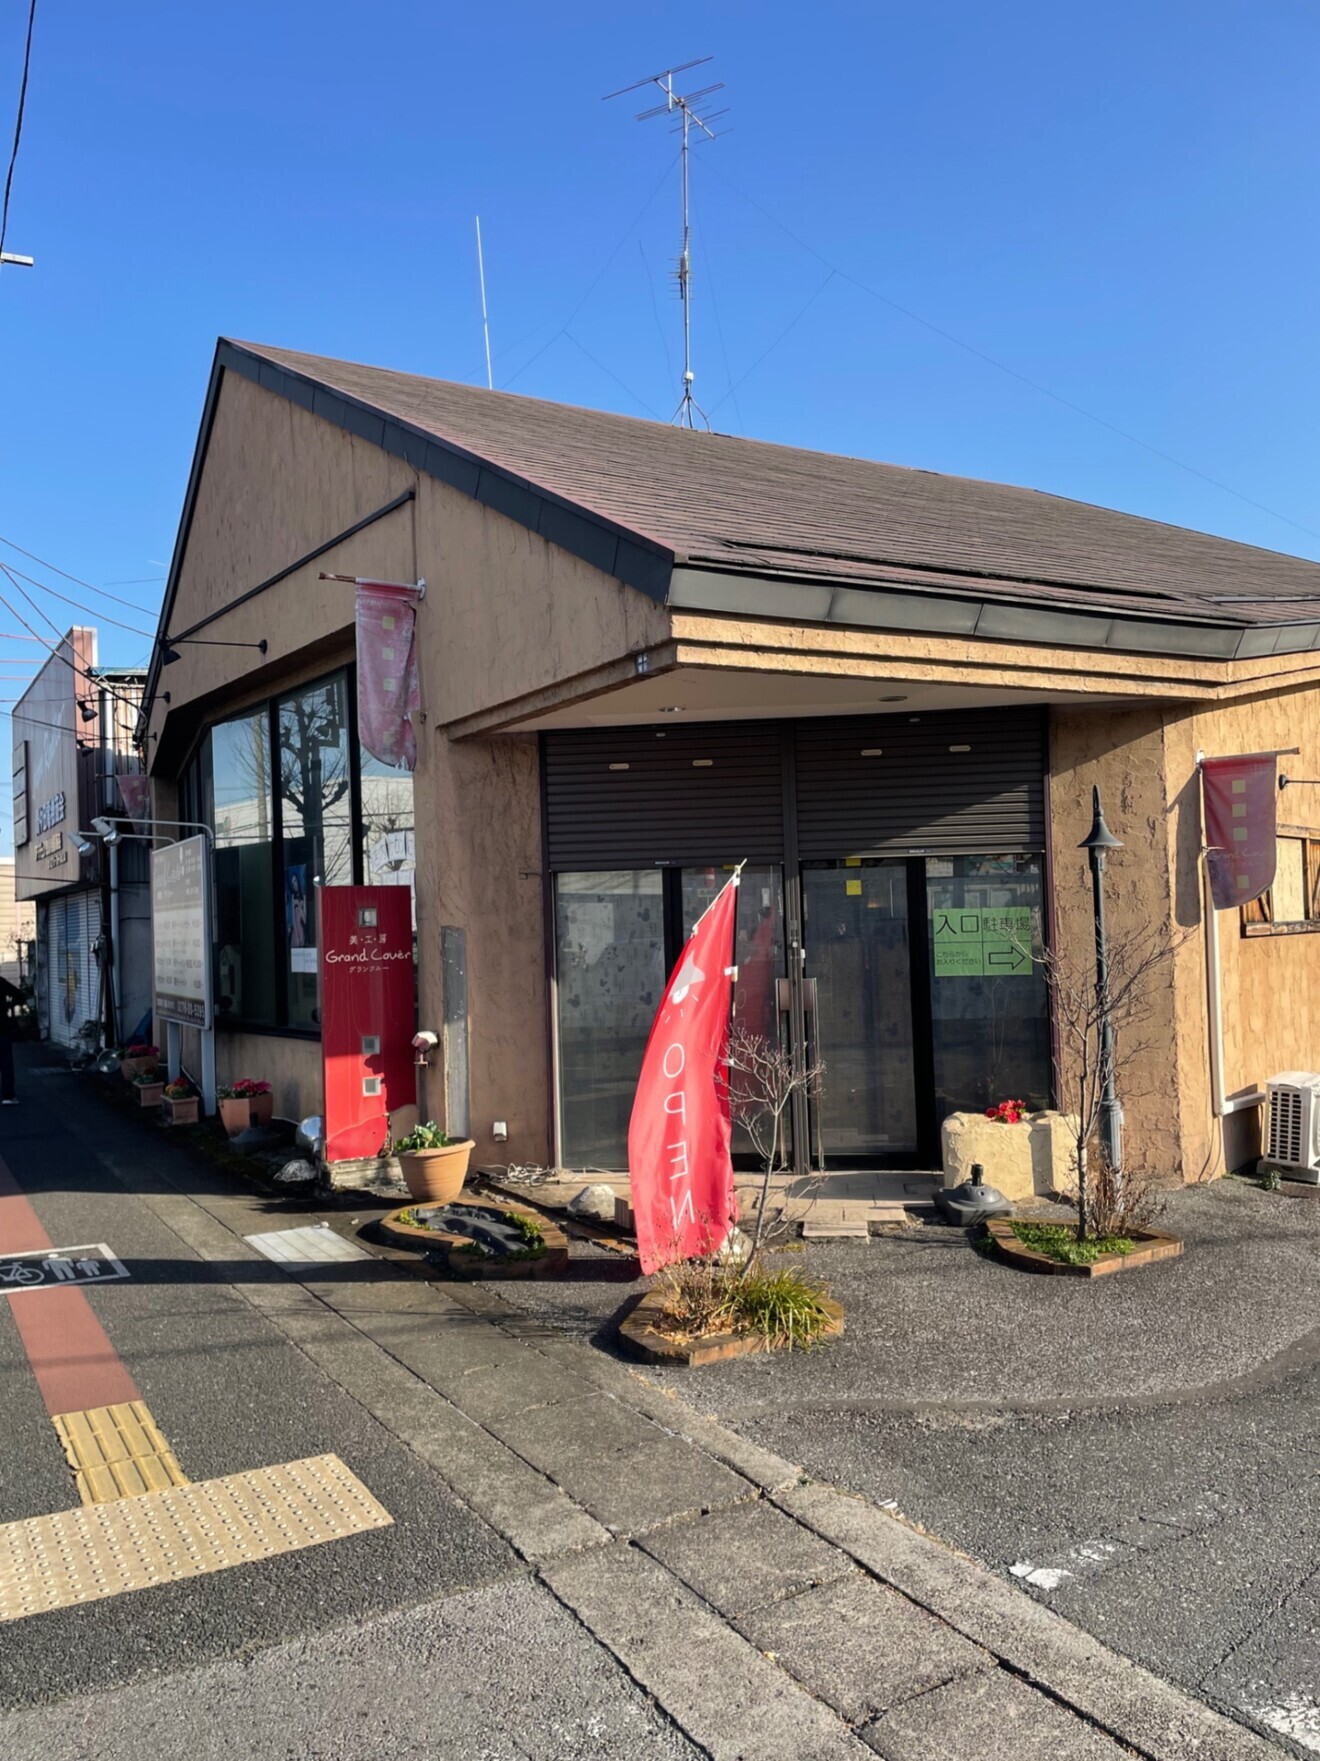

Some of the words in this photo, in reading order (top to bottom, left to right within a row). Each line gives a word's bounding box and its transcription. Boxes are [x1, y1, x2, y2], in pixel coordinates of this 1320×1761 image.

[936, 914, 979, 935] 入口
[983, 916, 1030, 932] 駐車場
[325, 947, 369, 963] Grand
